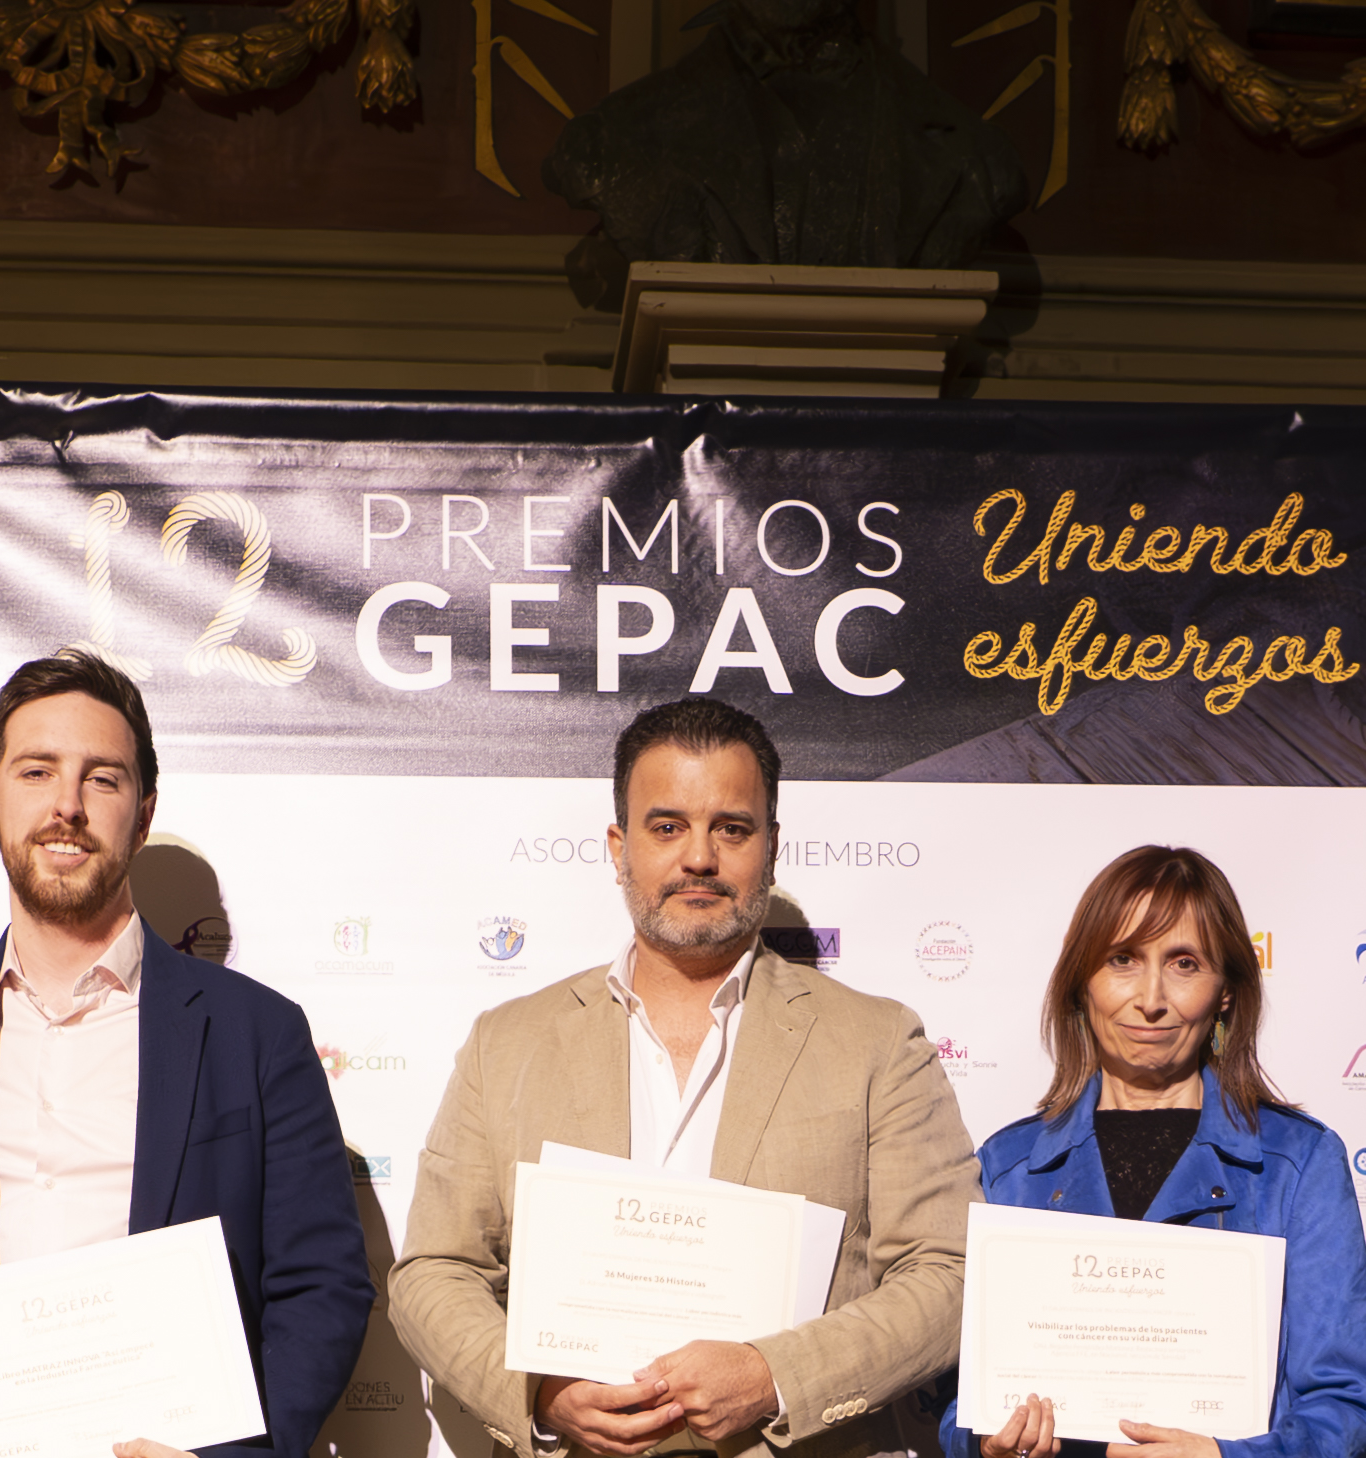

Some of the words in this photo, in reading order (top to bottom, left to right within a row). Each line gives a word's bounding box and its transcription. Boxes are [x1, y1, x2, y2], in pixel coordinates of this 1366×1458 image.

[973, 489, 1348, 587] Uniendo
[70, 489, 318, 688] 12
[360, 492, 905, 578] PREMIOS
[354, 580, 906, 697] GEPAC
[963, 595, 1361, 717] esfuerzos
[776, 841, 921, 867] MIEMBRO
[477, 916, 528, 931] ACAMED
[922, 945, 968, 956] ACEPAIN
[614, 1196, 646, 1223] 12
[650, 1201, 708, 1217] PREMIOS
[649, 1211, 707, 1228] GEPAC
[613, 1225, 656, 1240] Uniendo
[658, 1231, 705, 1247] esfuerzos
[1071, 1253, 1103, 1279] 12
[1106, 1256, 1165, 1269] PREMIOS
[1106, 1265, 1166, 1280] GEPAC
[604, 1269, 616, 1279] 36
[616, 1271, 653, 1282] Mujeres
[654, 1275, 665, 1284] 36
[666, 1276, 706, 1288] Historias
[1071, 1281, 1116, 1295] Uniendo
[1118, 1283, 1166, 1299] esfuerzos
[20, 1296, 55, 1324] 12
[56, 1290, 115, 1314] GEPAC
[1027, 1320, 1074, 1331] Visibilizar
[1074, 1322, 1088, 1332] los
[1088, 1323, 1137, 1334] problemas
[1137, 1324, 1150, 1333] de
[1150, 1324, 1164, 1334] los
[1164, 1326, 1208, 1337] pacientes
[1057, 1332, 1074, 1340] con
[1074, 1331, 1106, 1341] cáncer
[1106, 1333, 1118, 1341] en
[1118, 1333, 1130, 1341] su
[1130, 1333, 1150, 1342] vida
[1151, 1334, 1179, 1344] diaria
[536, 1330, 558, 1350] 12
[560, 1340, 599, 1354] GEPAC
[22, 1361, 63, 1377] MATRAZ
[63, 1352, 101, 1368] INNOVA
